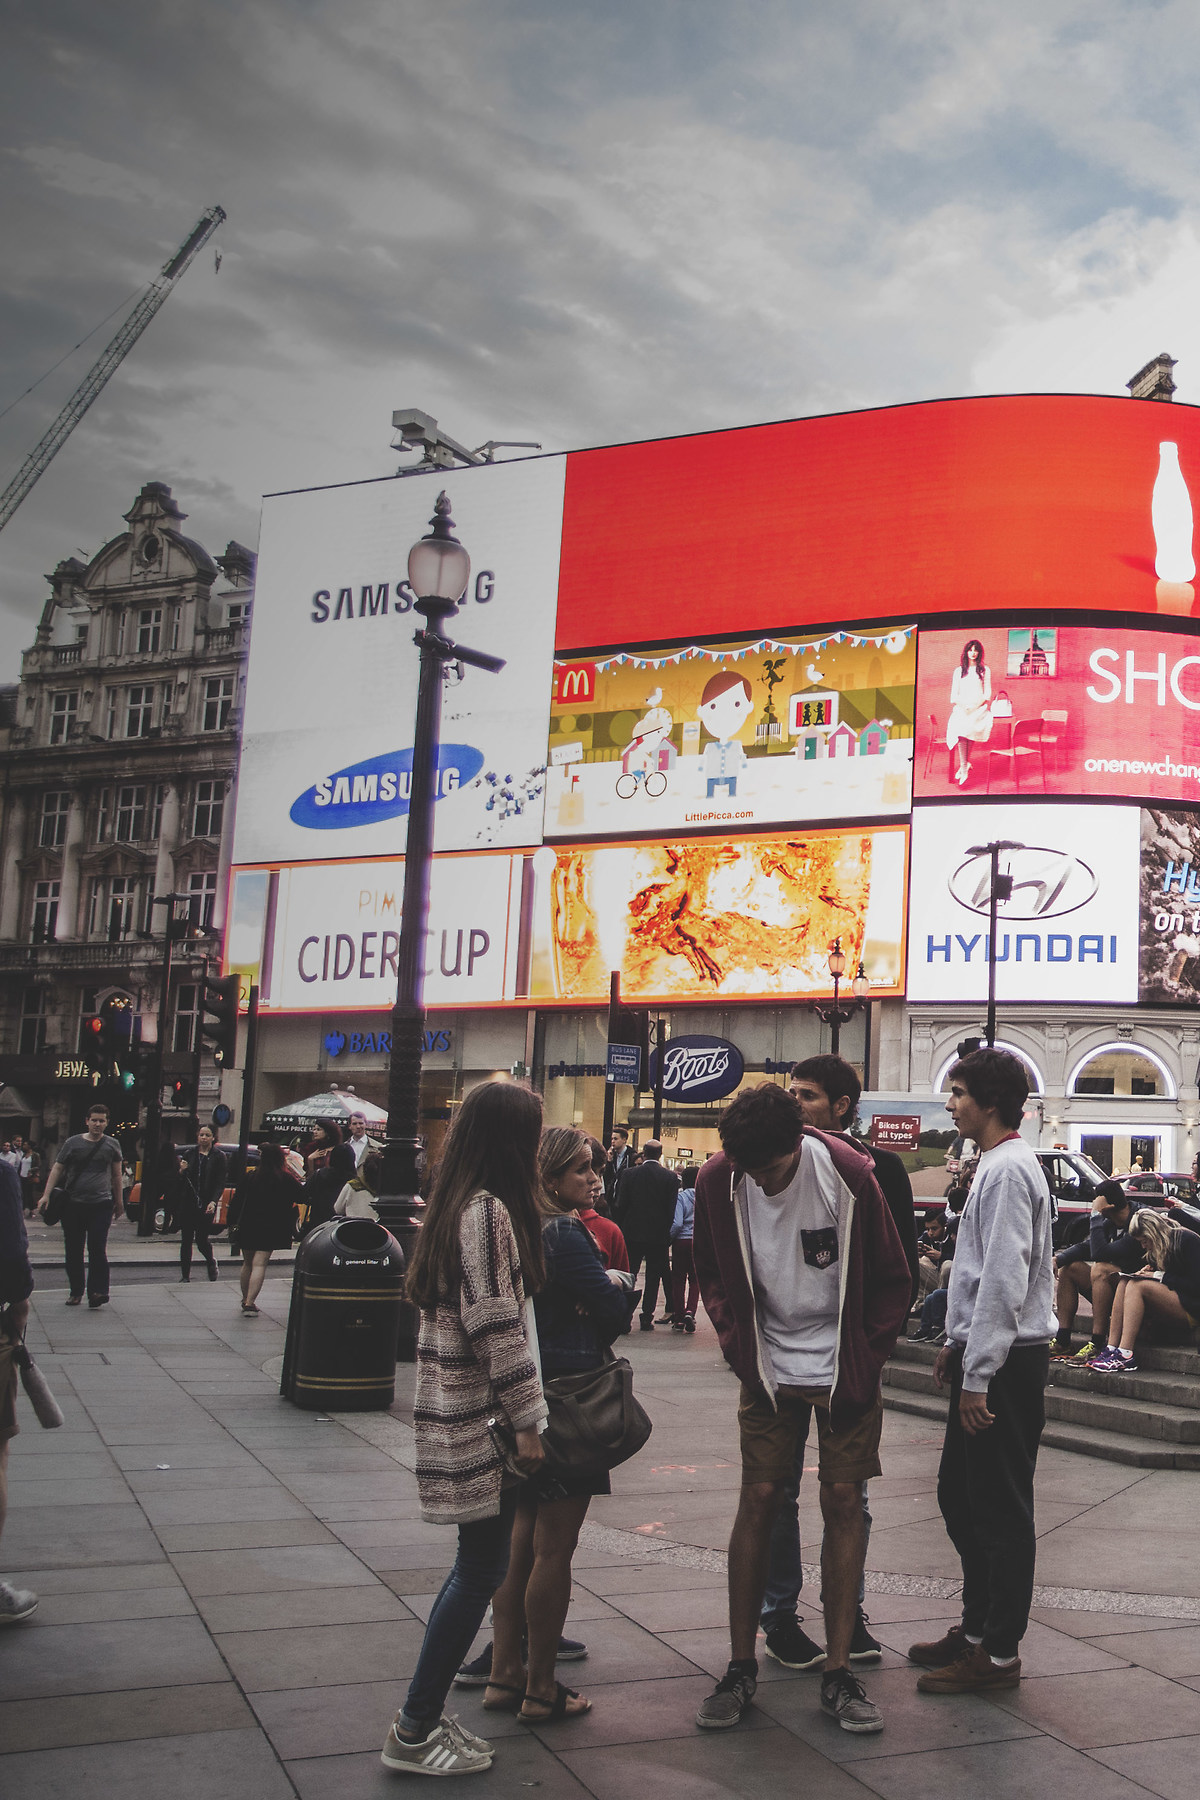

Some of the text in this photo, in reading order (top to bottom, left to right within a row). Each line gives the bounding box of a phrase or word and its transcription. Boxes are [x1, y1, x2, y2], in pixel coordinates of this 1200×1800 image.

[311, 570, 495, 623] SAMSG
[685, 810, 754, 822] LittlePicca.com
[357, 890, 403, 918] PIM
[1155, 911, 1184, 932] on
[297, 931, 400, 983] CIDER
[926, 933, 1117, 963] HYUNDAI
[349, 1030, 450, 1054] BARYS
[611, 1046, 637, 1055] BUS LANE
[655, 1046, 729, 1091] Boots
[877, 1130, 913, 1141] all types
[878, 1121, 914, 1130] Bikes for
